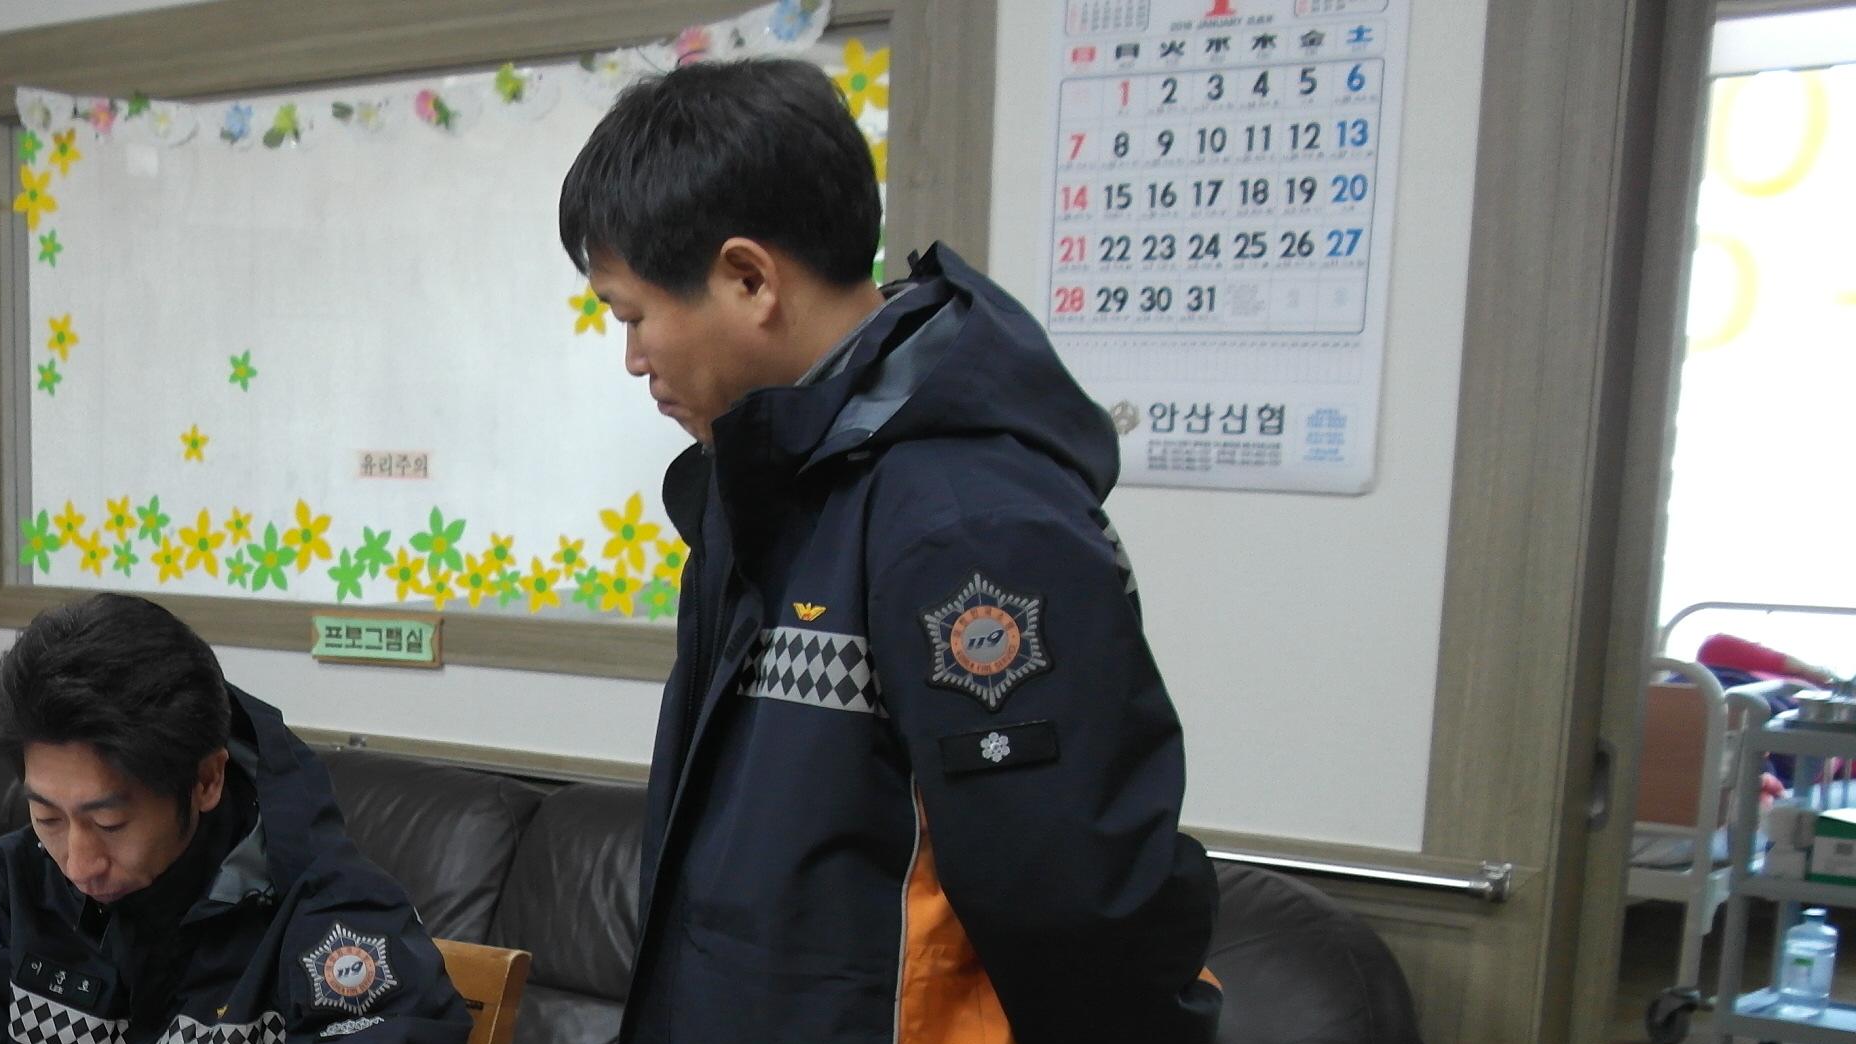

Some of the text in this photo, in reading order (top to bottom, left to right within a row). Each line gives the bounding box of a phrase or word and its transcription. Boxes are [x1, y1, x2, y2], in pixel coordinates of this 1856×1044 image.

[1160, 40, 1185, 57] 火
[1251, 32, 1277, 50] 木
[1347, 25, 1373, 43] 土
[1119, 64, 1365, 107] 1 2 3 4 5 6
[1070, 118, 1369, 160] 7 8 9 10 11 12 13
[1061, 173, 1369, 212] 14 15 16 17 18 19 20
[1060, 228, 1363, 262] 21 22 23 24 25 26 27
[1055, 286, 1085, 314] 28
[1096, 286, 1129, 313] 29
[1139, 286, 1173, 313] 30
[1187, 286, 1216, 313] 31
[1148, 401, 1285, 436] 안산신협
[360, 453, 429, 478] 유리주의
[325, 625, 423, 653] 프로그램실
[967, 629, 1005, 650] 119
